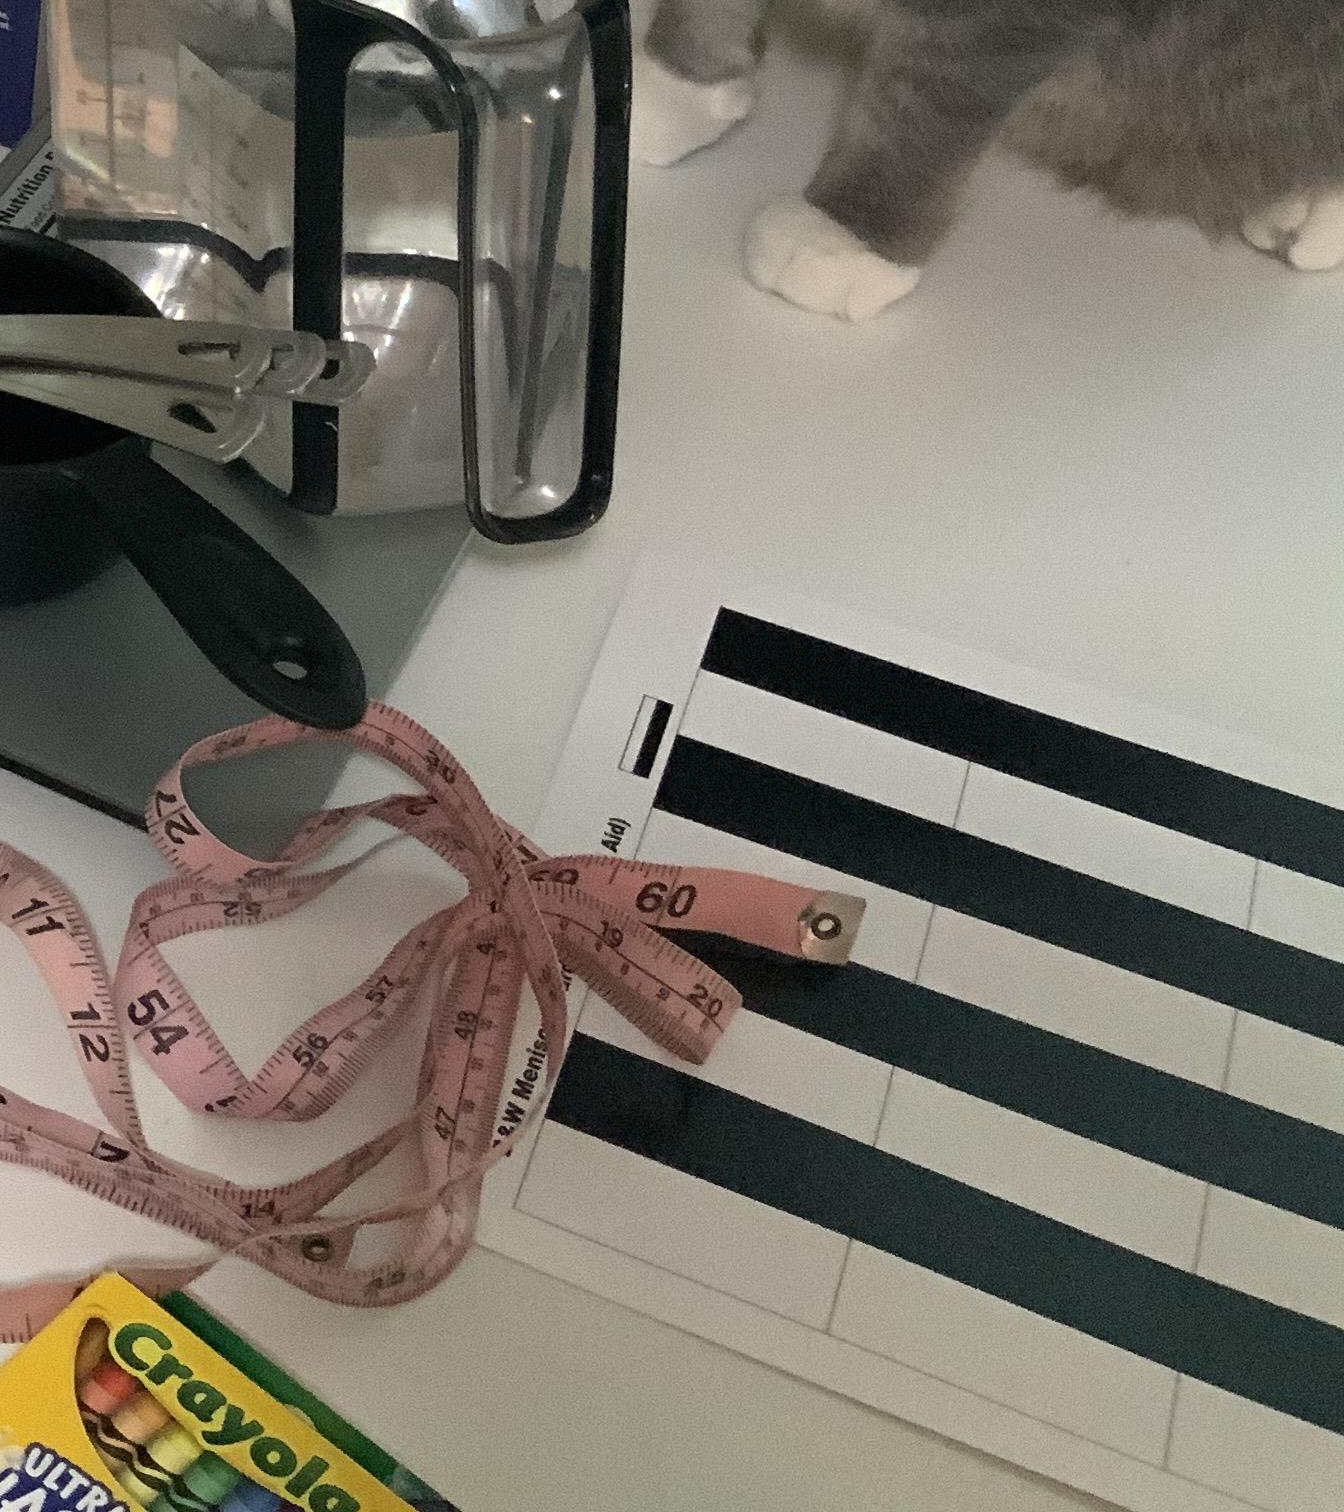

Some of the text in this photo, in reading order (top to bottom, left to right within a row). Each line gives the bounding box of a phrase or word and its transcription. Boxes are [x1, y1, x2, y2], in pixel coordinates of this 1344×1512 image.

[601, 816, 633, 854] Aid)
[12, 897, 65, 937] 11
[634, 881, 699, 919] 60
[685, 982, 724, 1019] 20
[68, 1001, 111, 1064] 12
[127, 988, 190, 1057] 54
[454, 1009, 479, 1042] 48
[291, 1031, 330, 1070] 56
[433, 1105, 457, 1143] 47
[111, 1321, 362, 1512] Crayola
